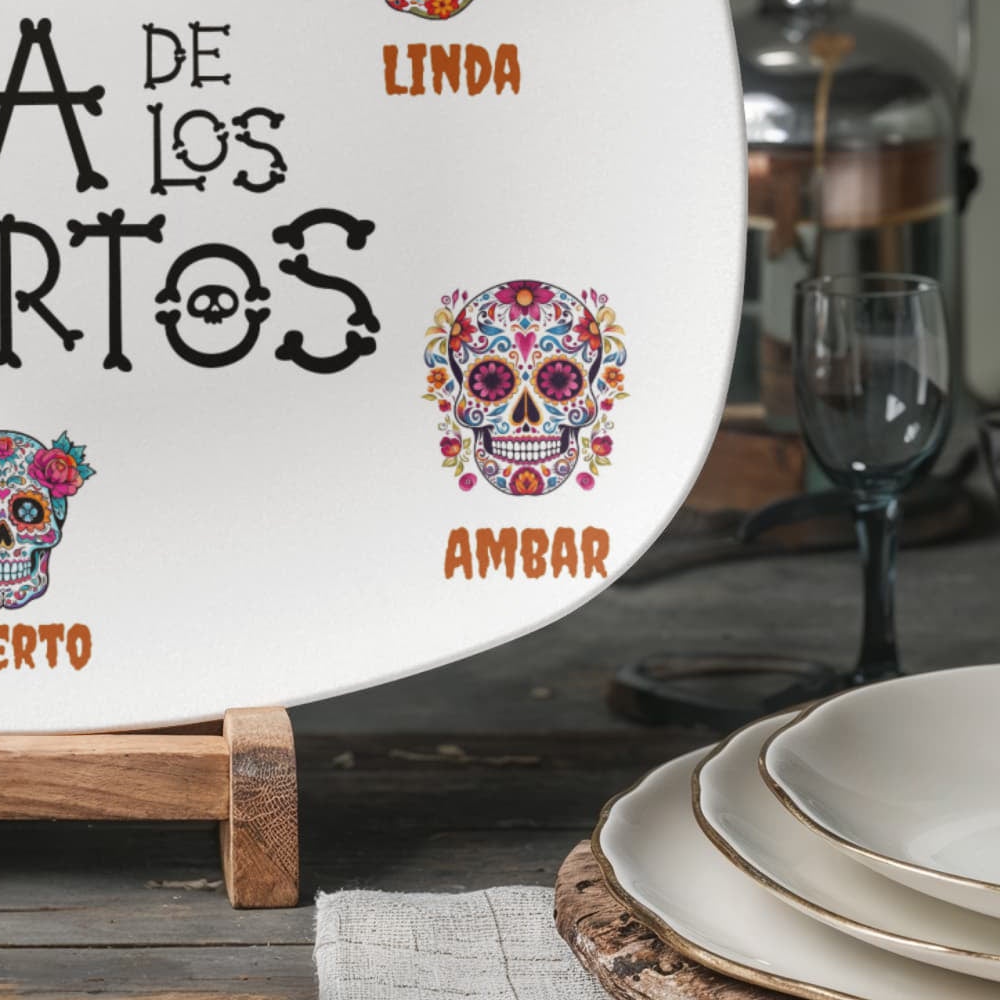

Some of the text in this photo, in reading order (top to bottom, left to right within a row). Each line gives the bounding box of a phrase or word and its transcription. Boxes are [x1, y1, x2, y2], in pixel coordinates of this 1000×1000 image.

[142, 21, 231, 90] DE
[382, 42, 521, 97] LINDA
[146, 102, 288, 196] LOS
[443, 525, 610, 580] AMBAR
